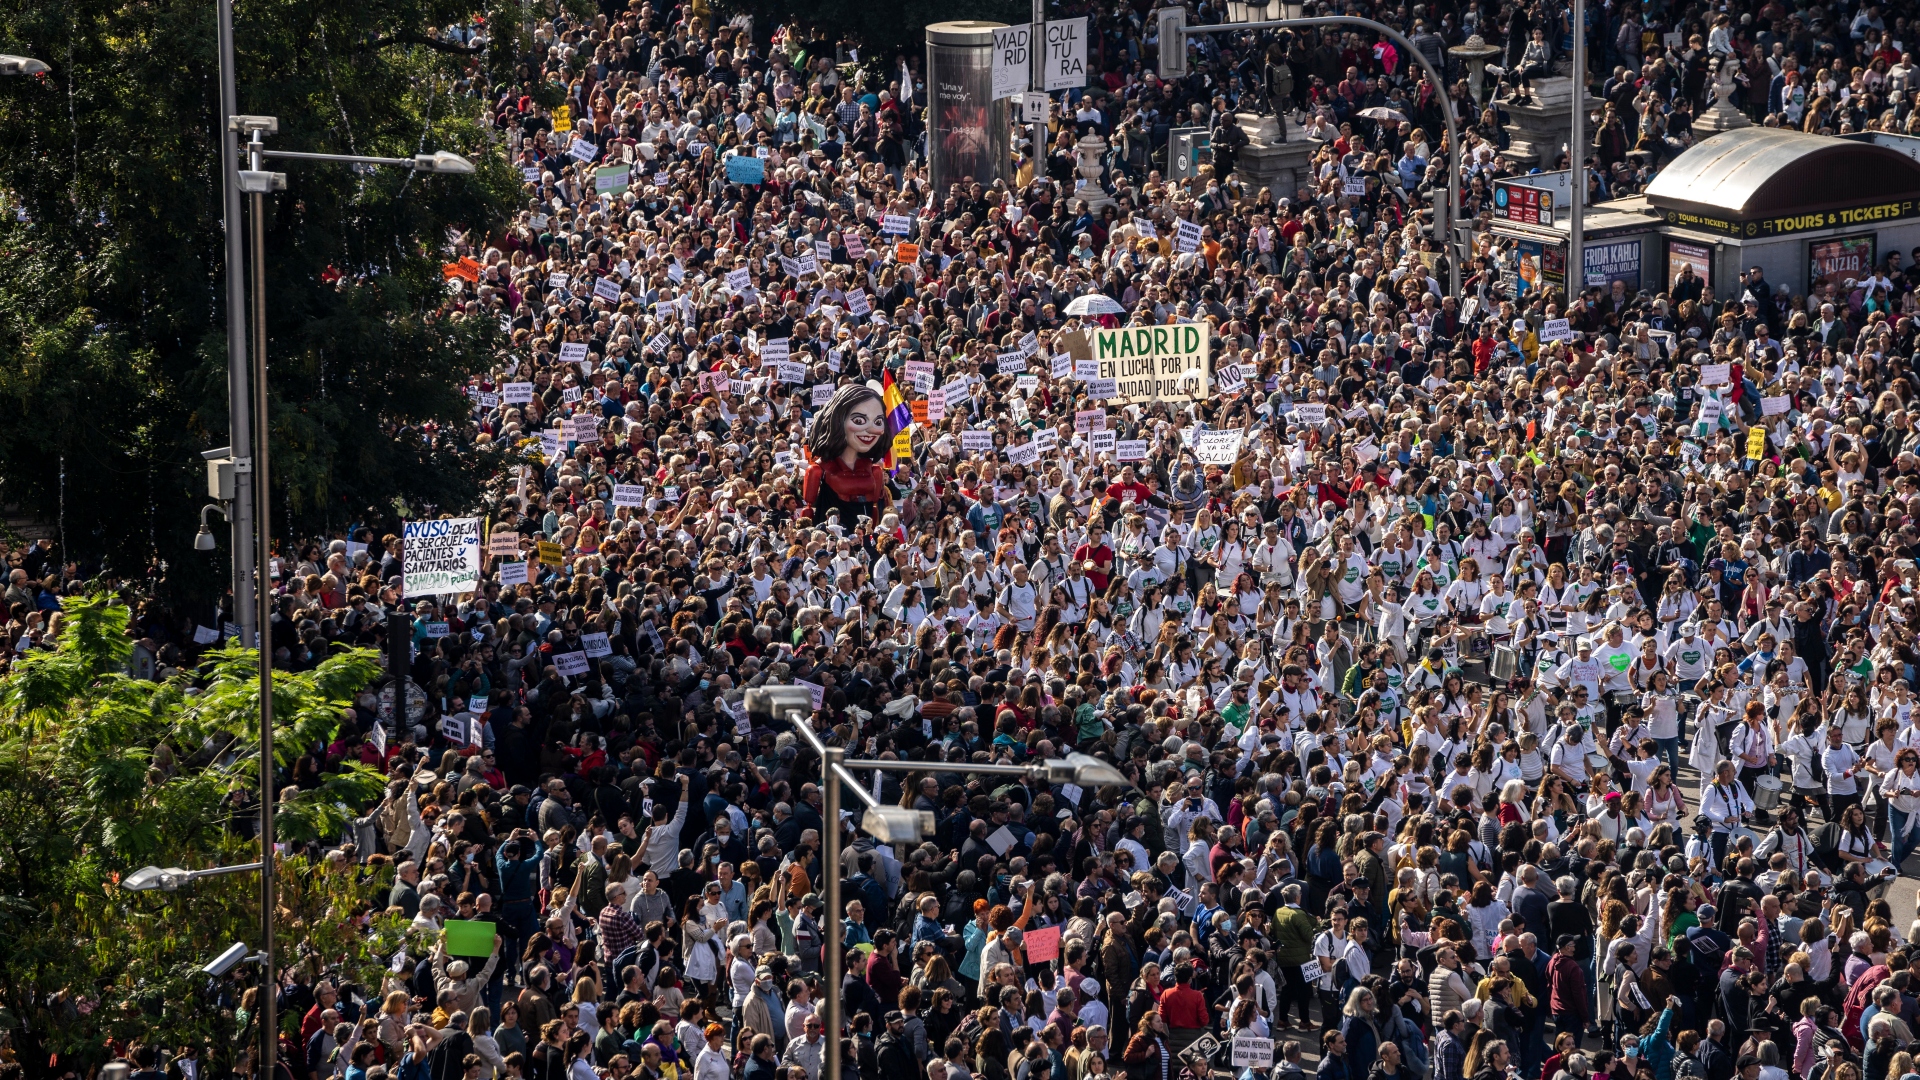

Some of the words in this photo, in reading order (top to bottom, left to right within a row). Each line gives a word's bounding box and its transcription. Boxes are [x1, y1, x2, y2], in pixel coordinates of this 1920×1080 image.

[994, 31, 1028, 49] MAD
[1049, 25, 1077, 42] CUL
[1004, 48, 1026, 65] RID
[1052, 42, 1072, 59] TU
[1061, 58, 1083, 76] RA
[1678, 213, 1698, 222] TOURS
[1704, 217, 1728, 228] TICKETS
[1775, 215, 1824, 232] TOURS
[1828, 214, 1836, 224] &
[1840, 203, 1900, 223] TICKETS
[1584, 249, 1607, 268] FRIDA
[1611, 242, 1639, 263] KAHLO
[1584, 265, 1600, 275] ALAS
[1602, 263, 1618, 274] PARA
[1620, 261, 1639, 271] VOLAR
[1680, 260, 1709, 271] MERNAL
[1826, 255, 1859, 274] LUZIA
[659, 334, 670, 344] NO
[1098, 327, 1199, 359] MADRID
[999, 353, 1024, 366] ¡ROBAN
[1000, 361, 1026, 374] SALUD!
[1101, 360, 1116, 378] EN
[1121, 358, 1155, 377] LUCHA
[1162, 357, 1181, 374] POR
[1220, 364, 1241, 387] NO
[731, 382, 741, 393] ASÍ
[1010, 446, 1037, 464] DIMISIÓN!
[1199, 452, 1234, 462] SALUD
[404, 520, 452, 538] AYUSO:
[452, 522, 477, 536] DEJA
[404, 540, 416, 550] DE
[417, 537, 433, 549] SER
[433, 536, 462, 547] CRUEL
[463, 536, 478, 545] con
[404, 547, 454, 562] PACIENTES
[457, 548, 466, 558] y
[404, 558, 467, 574] SANITARIOS
[404, 572, 449, 592] SANIDAD
[584, 639, 609, 651] DIMISIÓN!
[564, 655, 585, 663] AYUSO,
[567, 662, 587, 670] abusos.
[446, 720, 458, 728] AYUSO
[1166, 889, 1178, 900] ASÍ
[1179, 897, 1189, 909] NO
[1303, 963, 1321, 973] ¡ROBA
[1305, 971, 1323, 981] SALU
